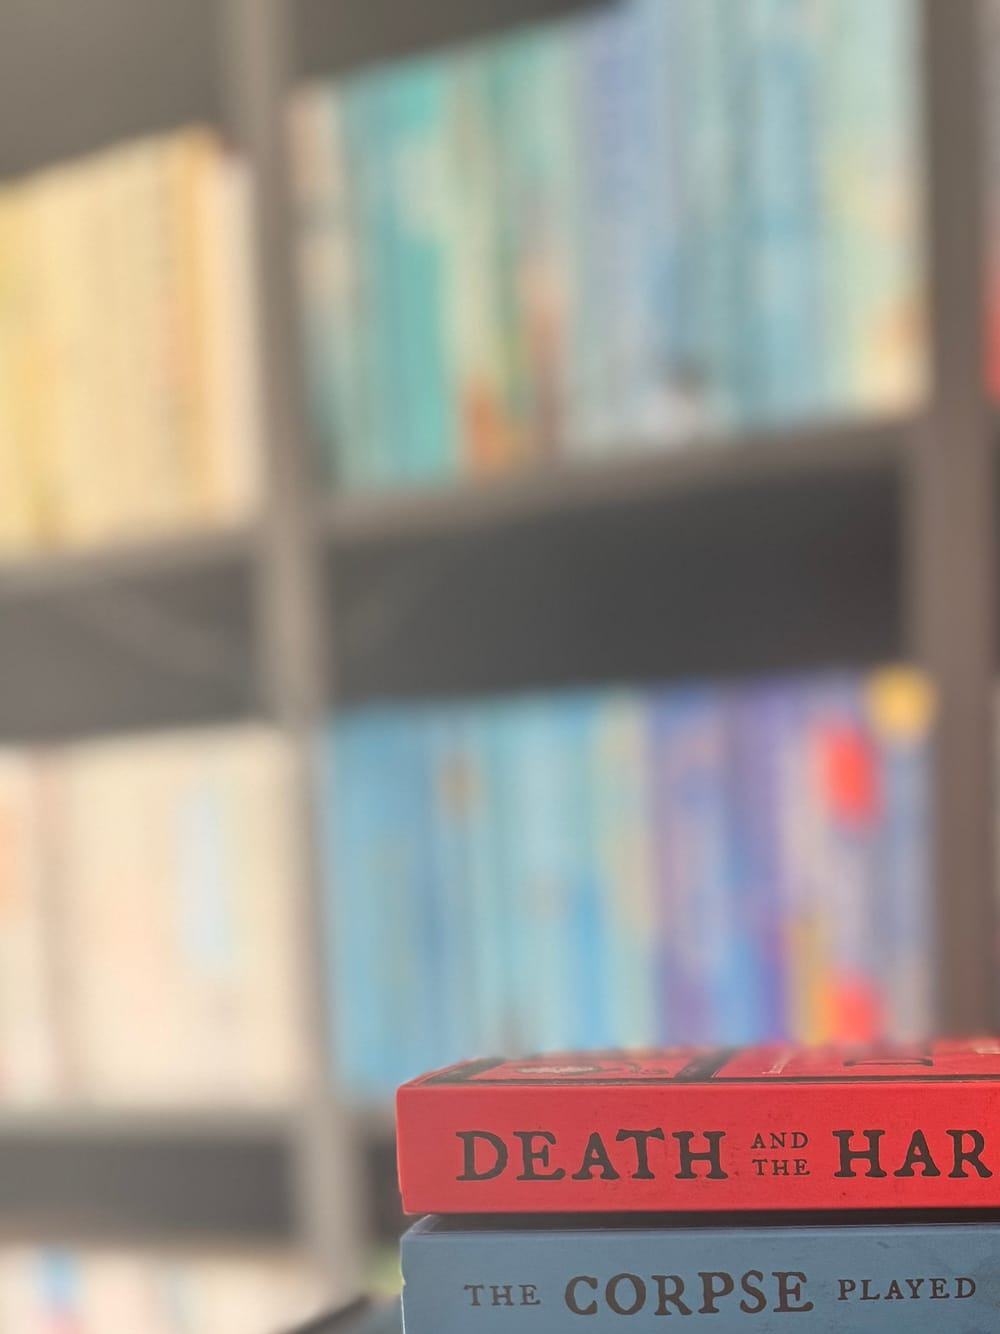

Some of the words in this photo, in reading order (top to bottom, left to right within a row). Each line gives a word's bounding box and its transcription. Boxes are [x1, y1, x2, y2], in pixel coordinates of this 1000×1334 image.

[456, 1128, 728, 1181] DEATH
[751, 1132, 809, 1149] AND
[752, 1159, 810, 1176] THE
[464, 1285, 542, 1306] THE
[565, 1270, 814, 1316] CORPSE
[838, 1278, 976, 1300] PLAYED
